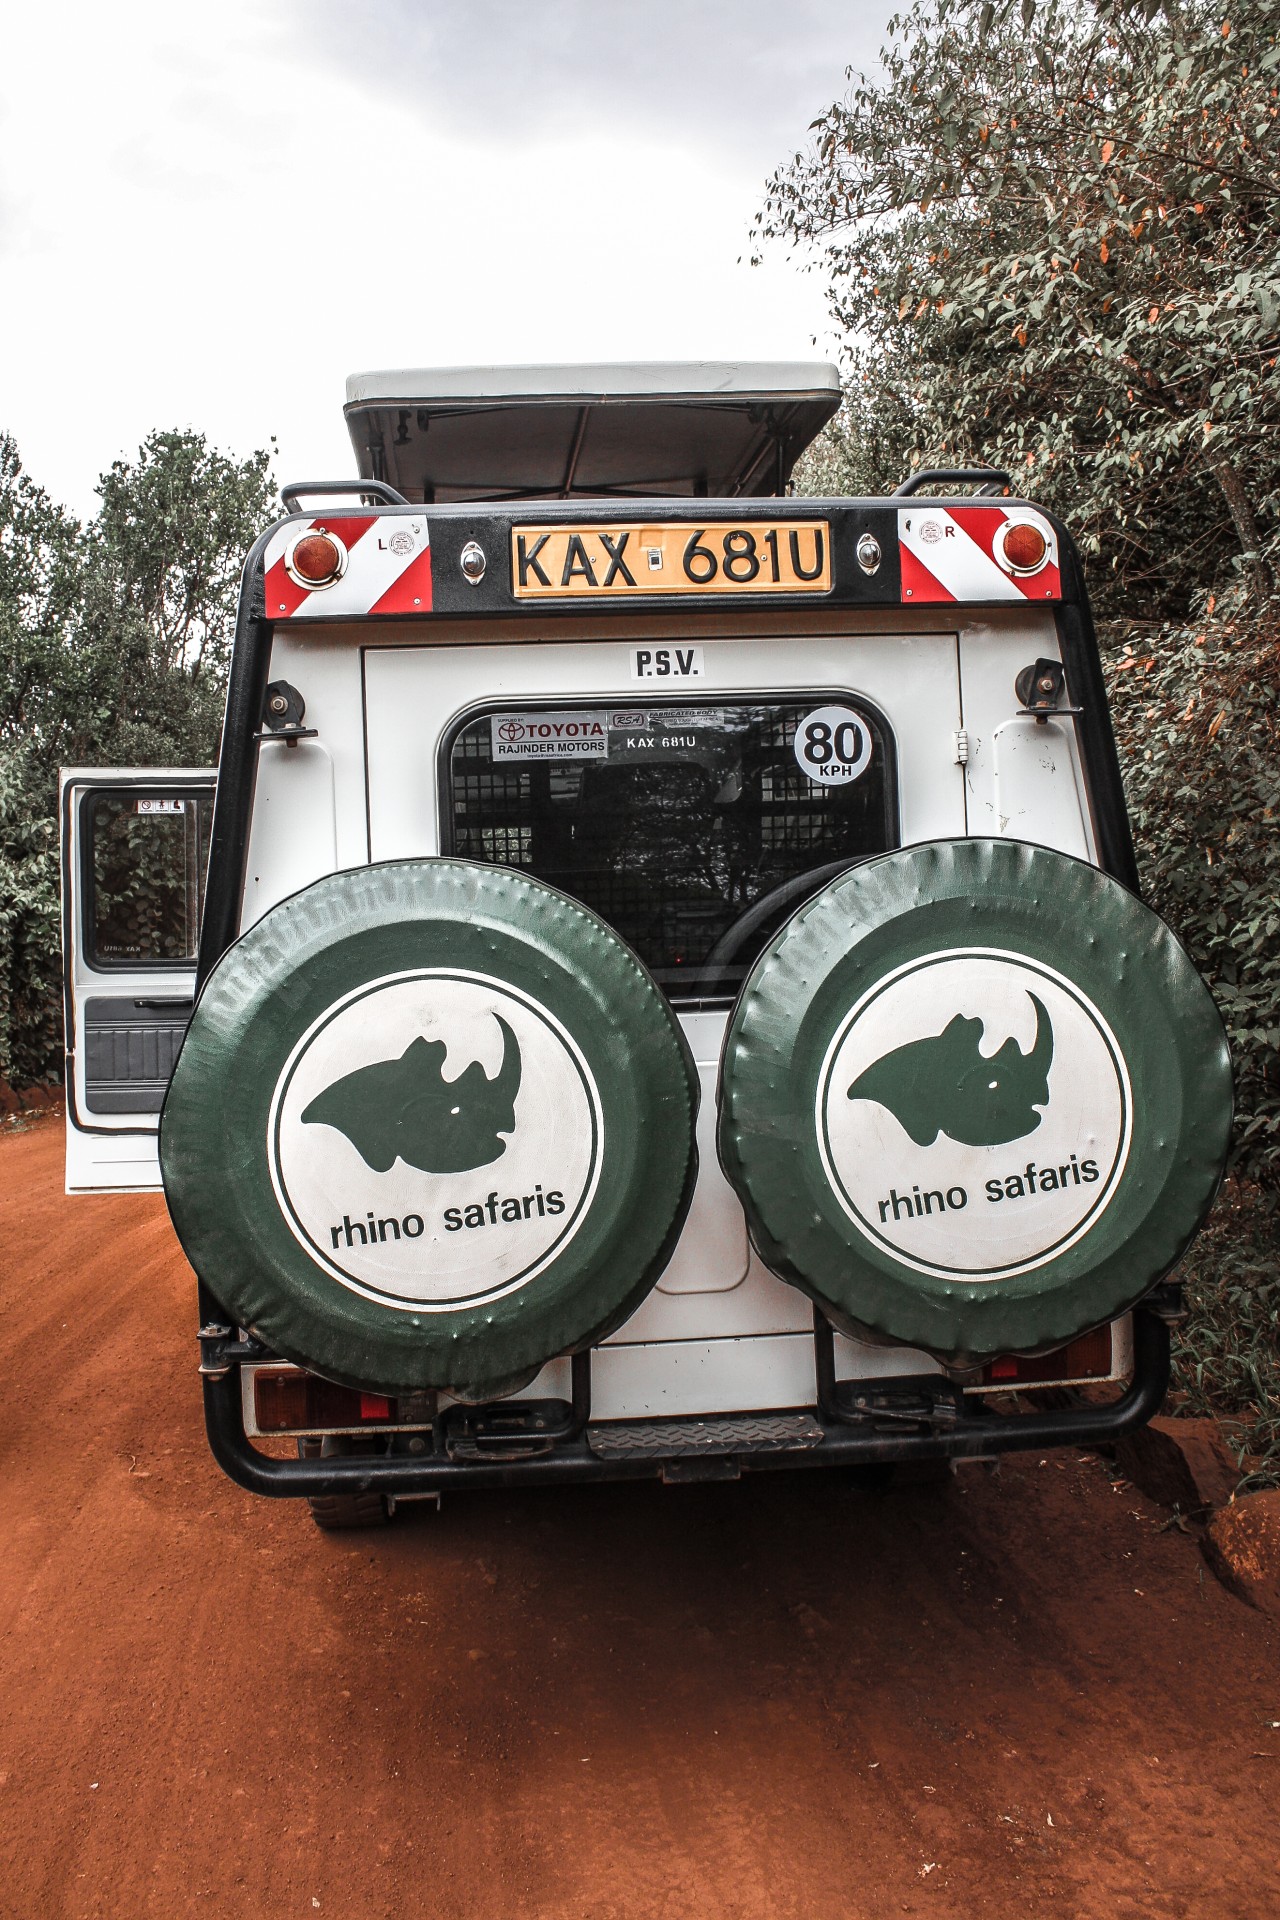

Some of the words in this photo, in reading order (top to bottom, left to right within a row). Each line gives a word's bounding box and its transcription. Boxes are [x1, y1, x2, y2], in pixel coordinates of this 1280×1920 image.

[944, 525, 956, 538] R
[378, 538, 387, 551] L
[517, 533, 638, 587] KAX
[682, 529, 824, 584] 681U
[636, 649, 699, 677] P.S.V.
[616, 715, 641, 725] RSA
[526, 722, 604, 738] TOYOTA
[498, 743, 554, 754] RAJINDER
[557, 741, 605, 752] MOTORS
[627, 737, 654, 748] KAX
[662, 736, 696, 748] 681U
[803, 721, 863, 765] 80
[819, 765, 852, 777] KPH
[878, 1185, 967, 1223] rhino
[985, 1154, 1100, 1202] safaris
[330, 1212, 424, 1249] rhino
[443, 1184, 566, 1231] safaris
